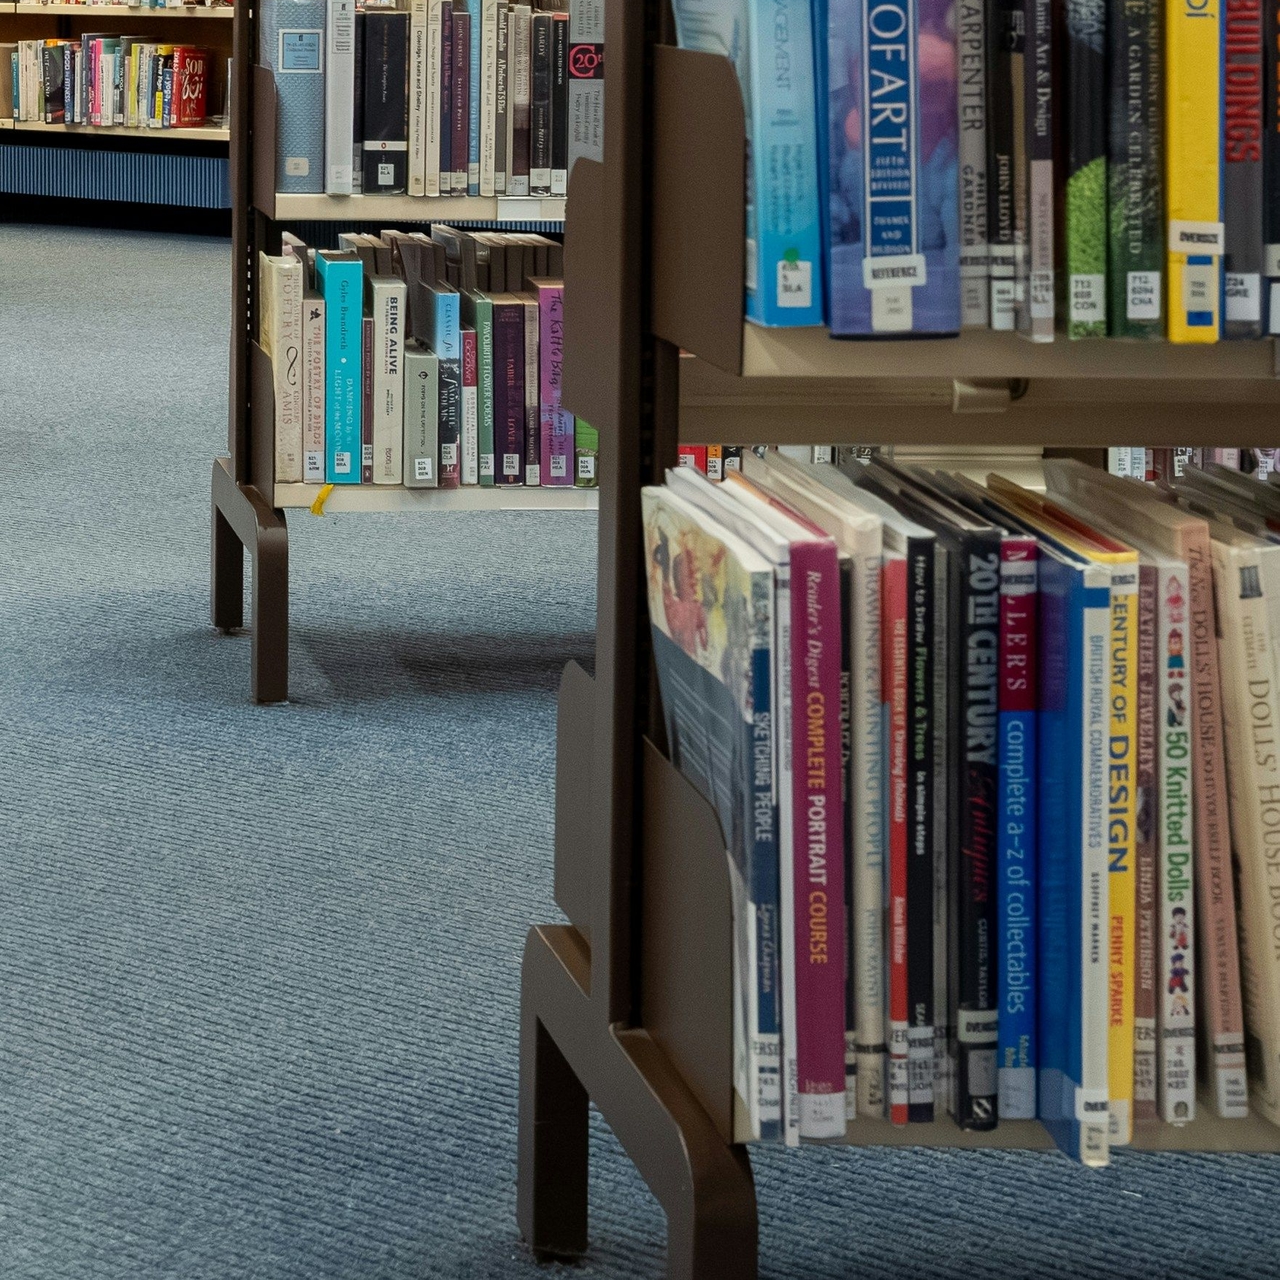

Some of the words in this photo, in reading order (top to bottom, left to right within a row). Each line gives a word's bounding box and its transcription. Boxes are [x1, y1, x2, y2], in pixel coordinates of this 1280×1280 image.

[868, 5, 907, 63] OF
[869, 68, 908, 153] ART
[389, 297, 398, 335] BEING
[389, 339, 397, 375] ALIVE
[969, 554, 997, 622] 20TH
[967, 629, 993, 764] CENTURY
[806, 690, 826, 789] COMPLETE
[1001, 720, 1025, 817] complete
[1167, 732, 1188, 761] 50
[1108, 735, 1130, 872] DESIGN
[1165, 764, 1188, 845] Knitted
[807, 795, 829, 887] PORTRAIT
[1006, 822, 1025, 858] a-z
[1165, 849, 1186, 902] Dolls
[1006, 866, 1030, 889] of
[809, 892, 828, 963] COURSE
[1006, 892, 1030, 1014] collectables
